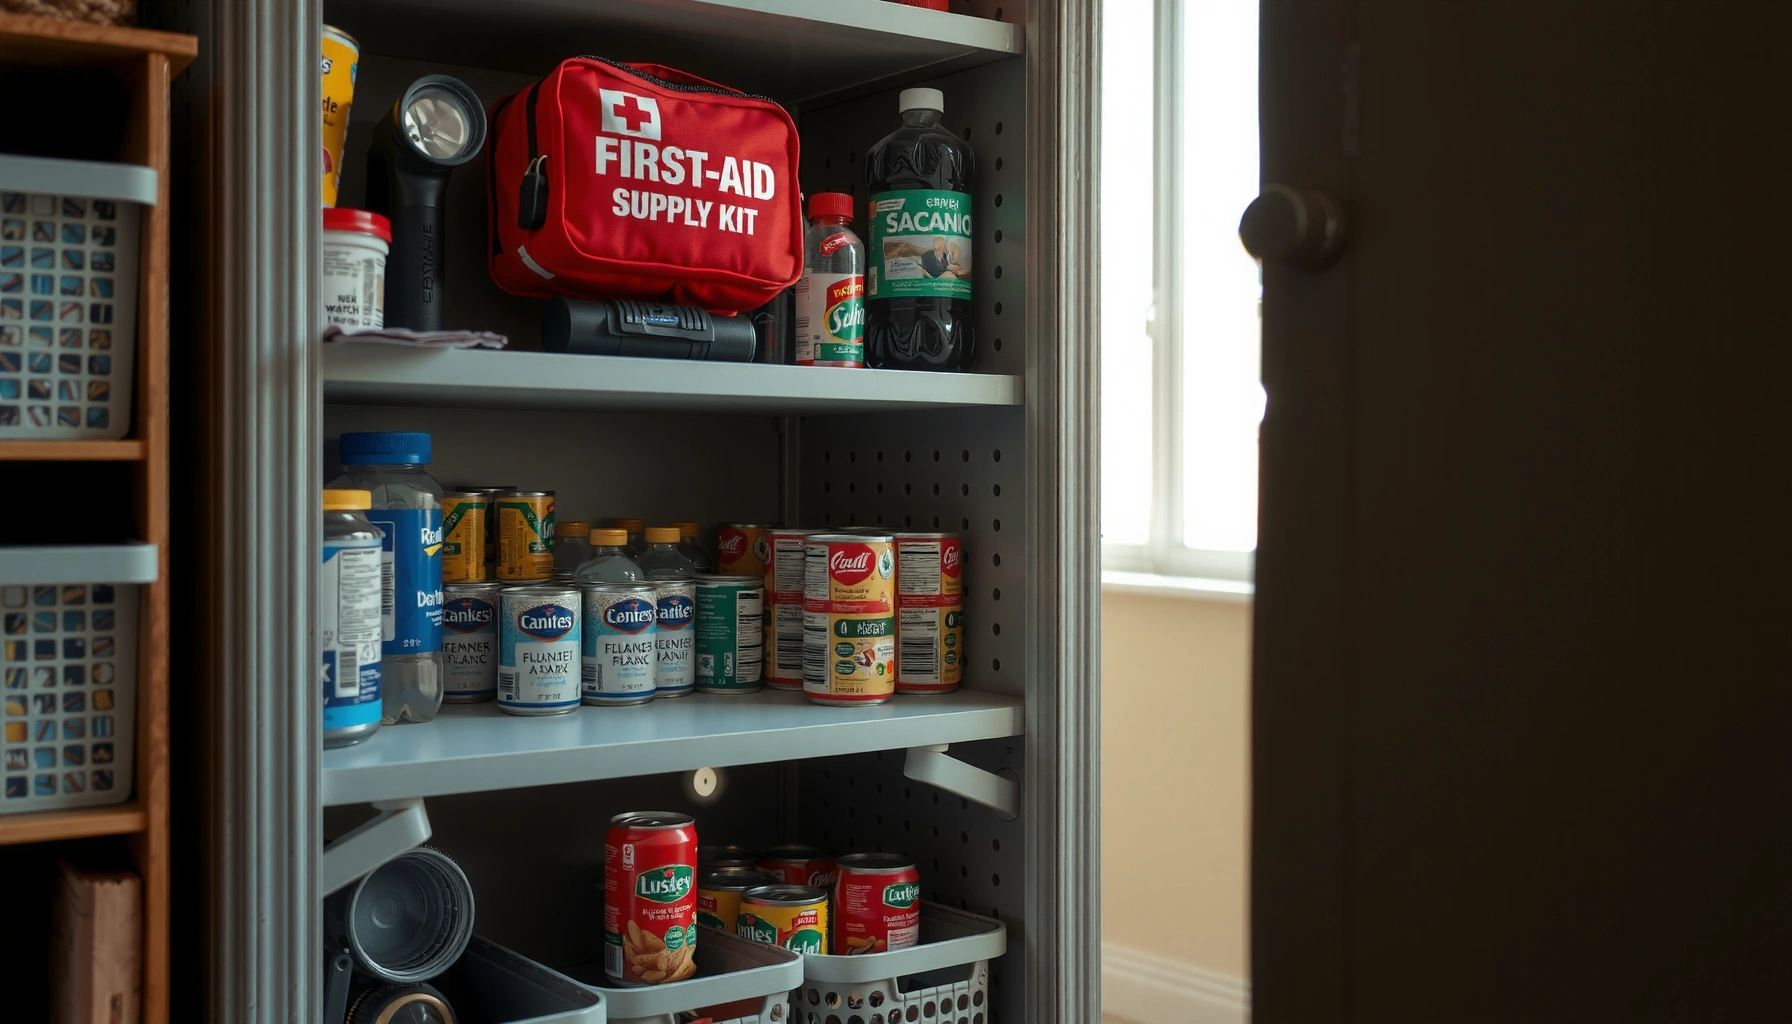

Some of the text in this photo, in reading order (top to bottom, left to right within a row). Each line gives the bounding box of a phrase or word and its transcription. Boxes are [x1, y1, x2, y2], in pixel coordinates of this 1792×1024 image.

[595, 136, 775, 201] FIRST-AID
[612, 188, 759, 236] SUPPLY KIT
